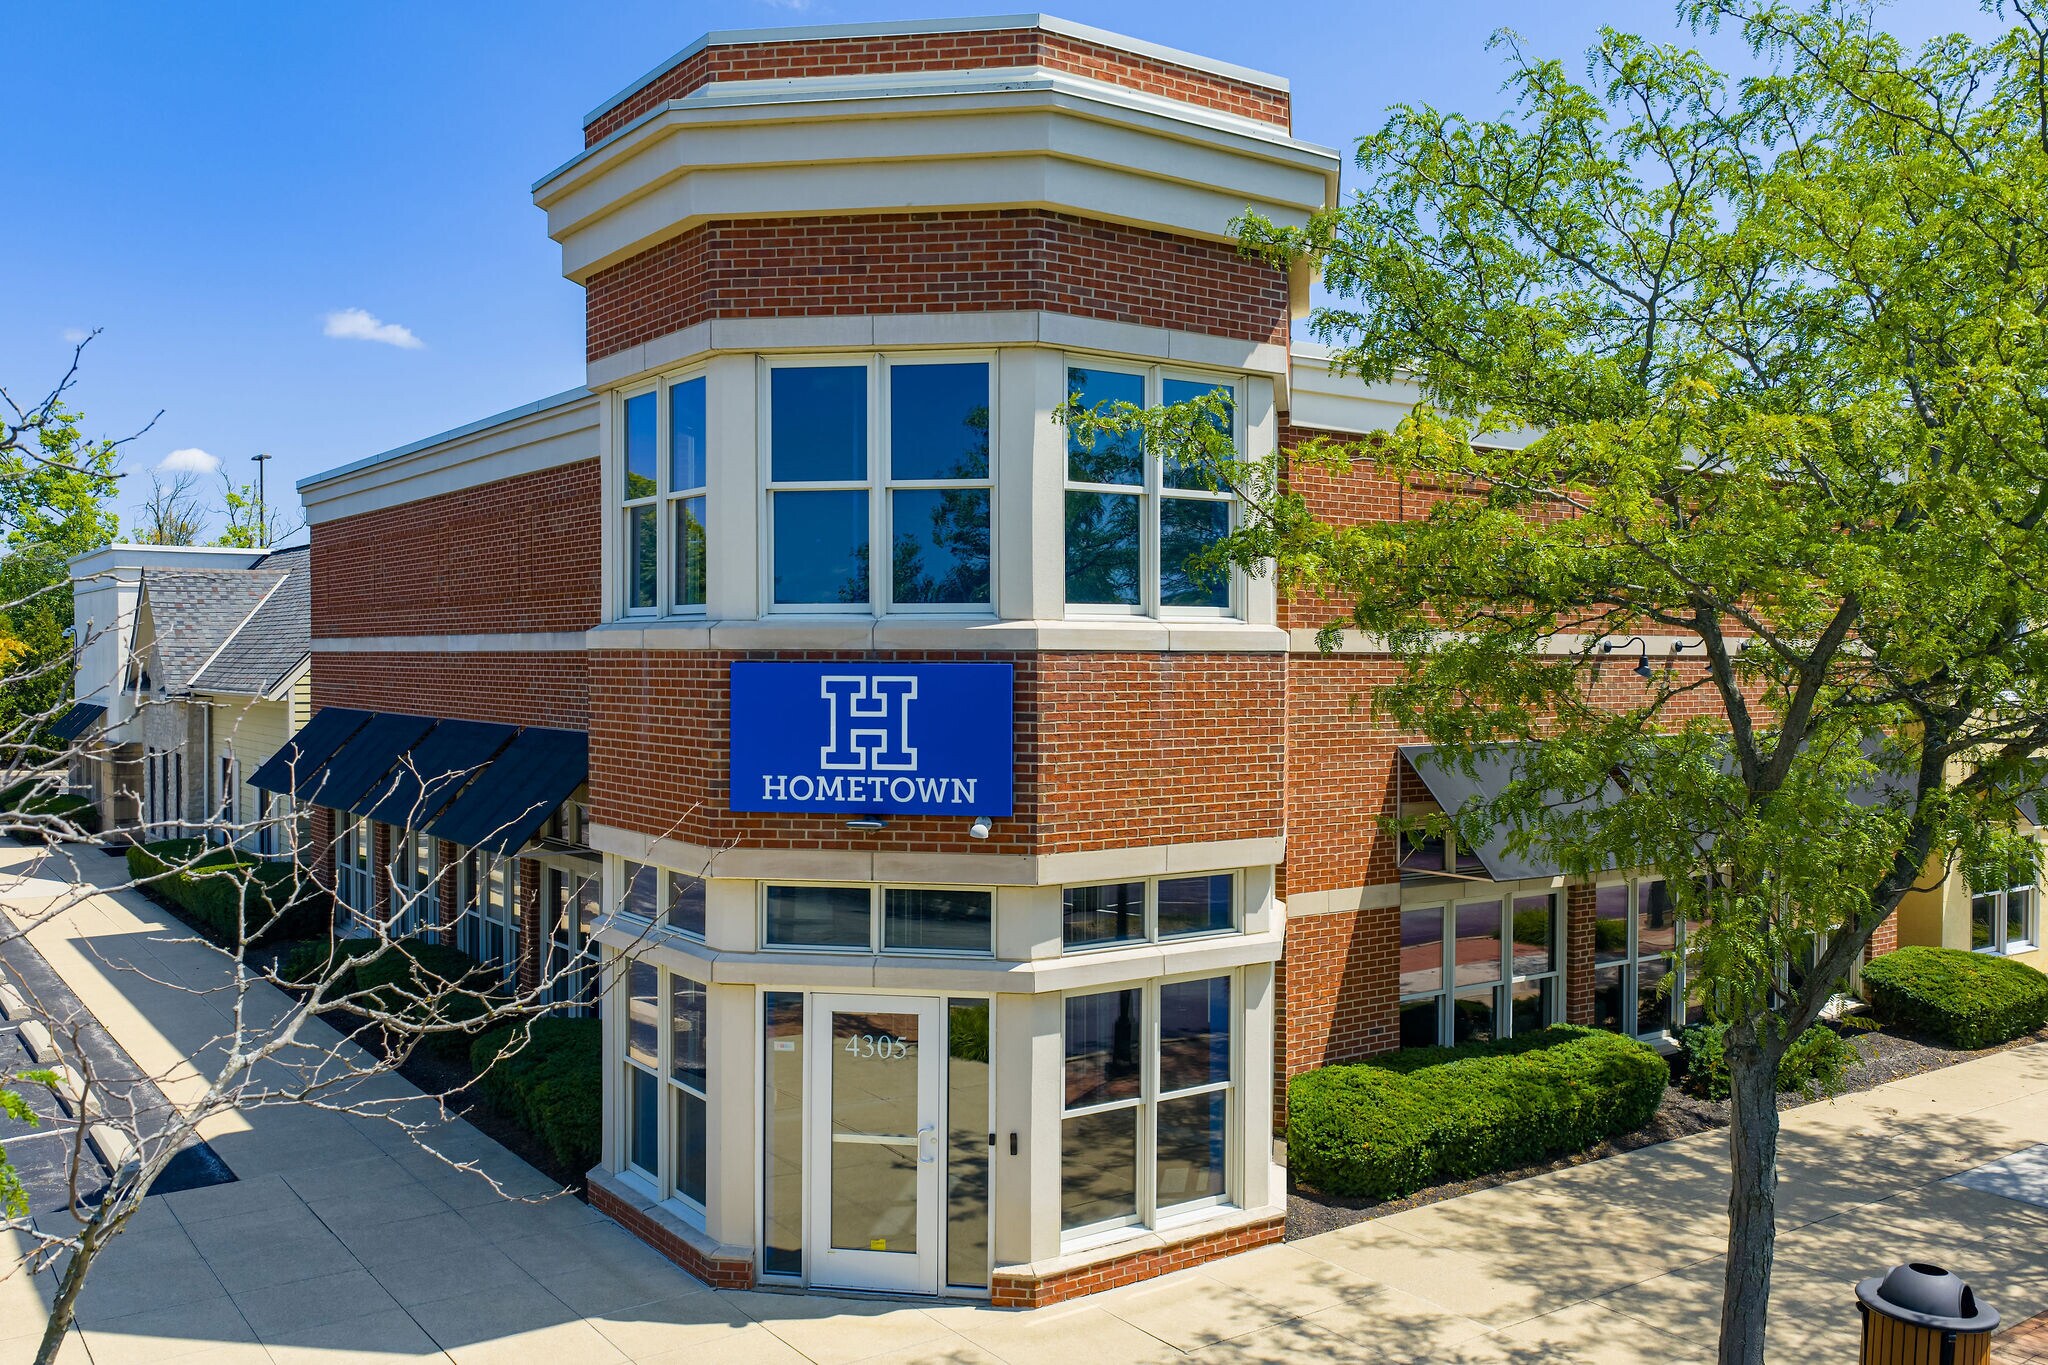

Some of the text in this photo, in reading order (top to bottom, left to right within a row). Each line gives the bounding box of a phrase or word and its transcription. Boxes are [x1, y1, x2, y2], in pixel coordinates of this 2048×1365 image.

[821, 675, 918, 771] H
[762, 775, 978, 804] HOMETOWN
[845, 1034, 907, 1059] 4305
